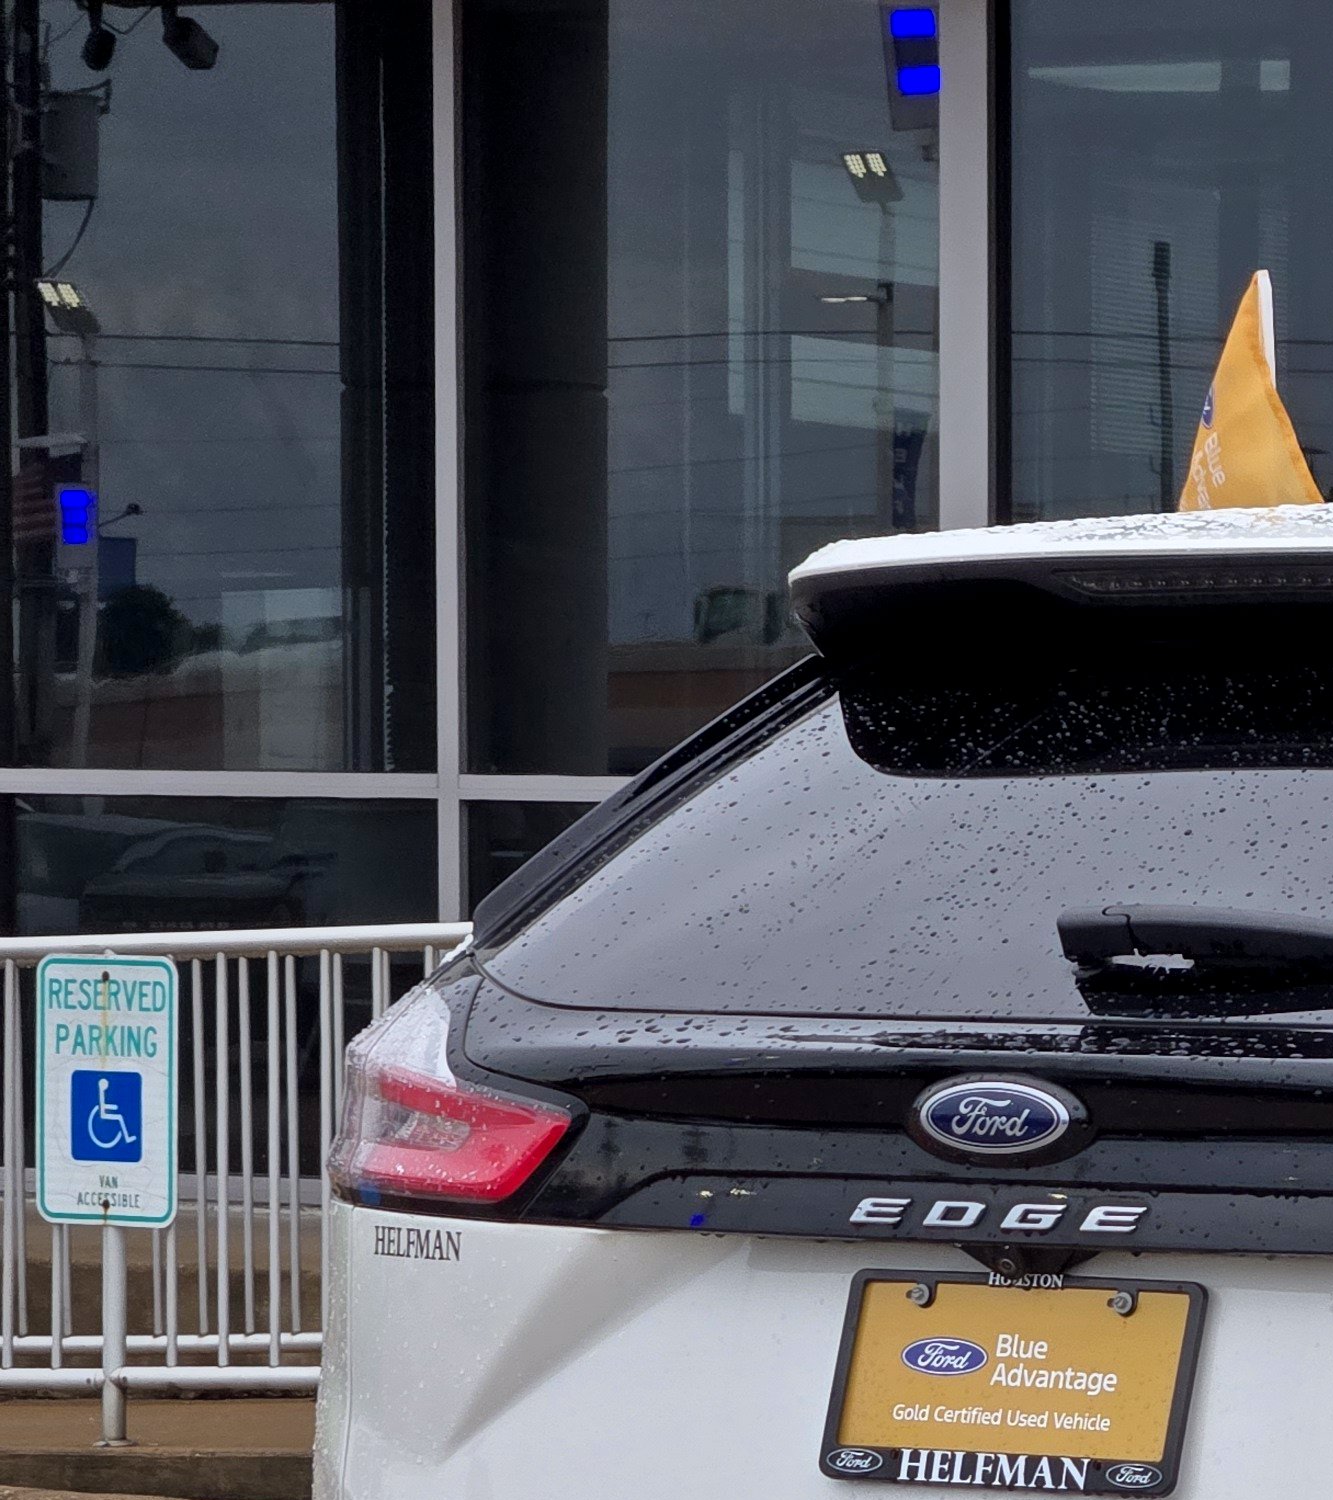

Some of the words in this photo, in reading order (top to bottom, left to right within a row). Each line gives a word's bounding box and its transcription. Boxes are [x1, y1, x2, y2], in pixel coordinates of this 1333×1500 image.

[1203, 431, 1226, 489] Blue
[47, 977, 167, 1013] RESERVED
[54, 1023, 159, 1059] PARKING
[951, 1095, 1029, 1138] Ford
[99, 1175, 119, 1189] VAN
[849, 1197, 1148, 1234] EDGE
[373, 1225, 463, 1262] HELFMAN
[917, 1342, 972, 1370] Ford
[995, 1333, 1048, 1360] Blue
[990, 1362, 1118, 1396] Advantage
[892, 1403, 930, 1422] Gold
[933, 1405, 1003, 1426] Certified
[1006, 1409, 1049, 1429] Used
[1053, 1412, 1111, 1432] Vehicle
[896, 1448, 1092, 1491] HELFMAN
